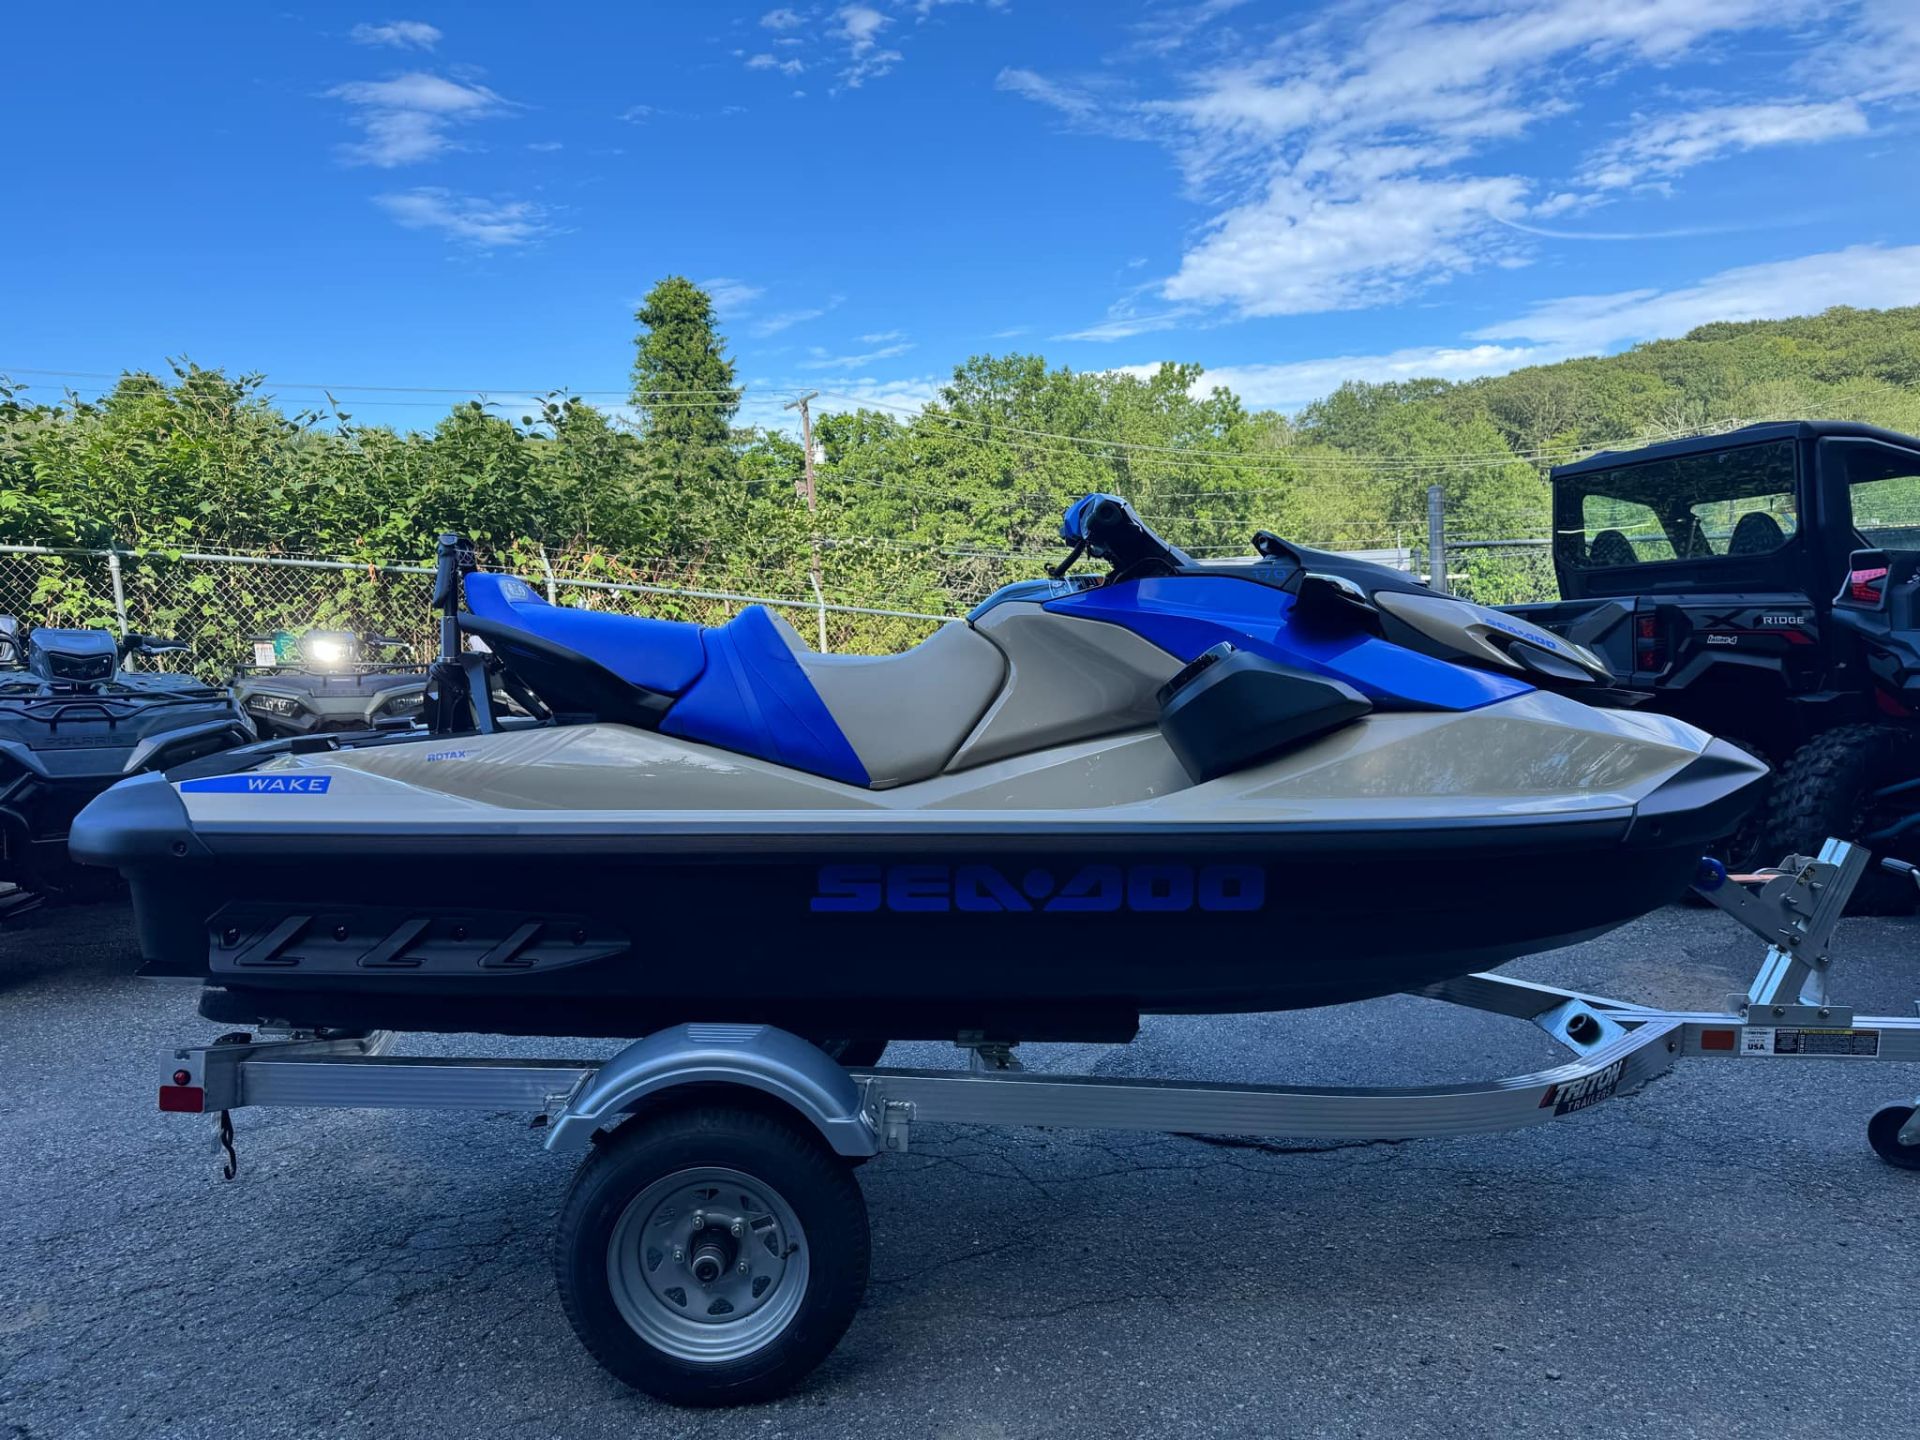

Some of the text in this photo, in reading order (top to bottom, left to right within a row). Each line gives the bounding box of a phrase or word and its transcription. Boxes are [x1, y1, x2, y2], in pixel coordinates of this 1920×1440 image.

[1763, 616, 1805, 625] RIDGE
[45, 736, 123, 746] POLARIS
[426, 750, 466, 762] ROTAX
[248, 778, 325, 792] WAKE
[1553, 1060, 1624, 1105] TRITON
[1567, 1086, 1612, 1112] TRAILERS
